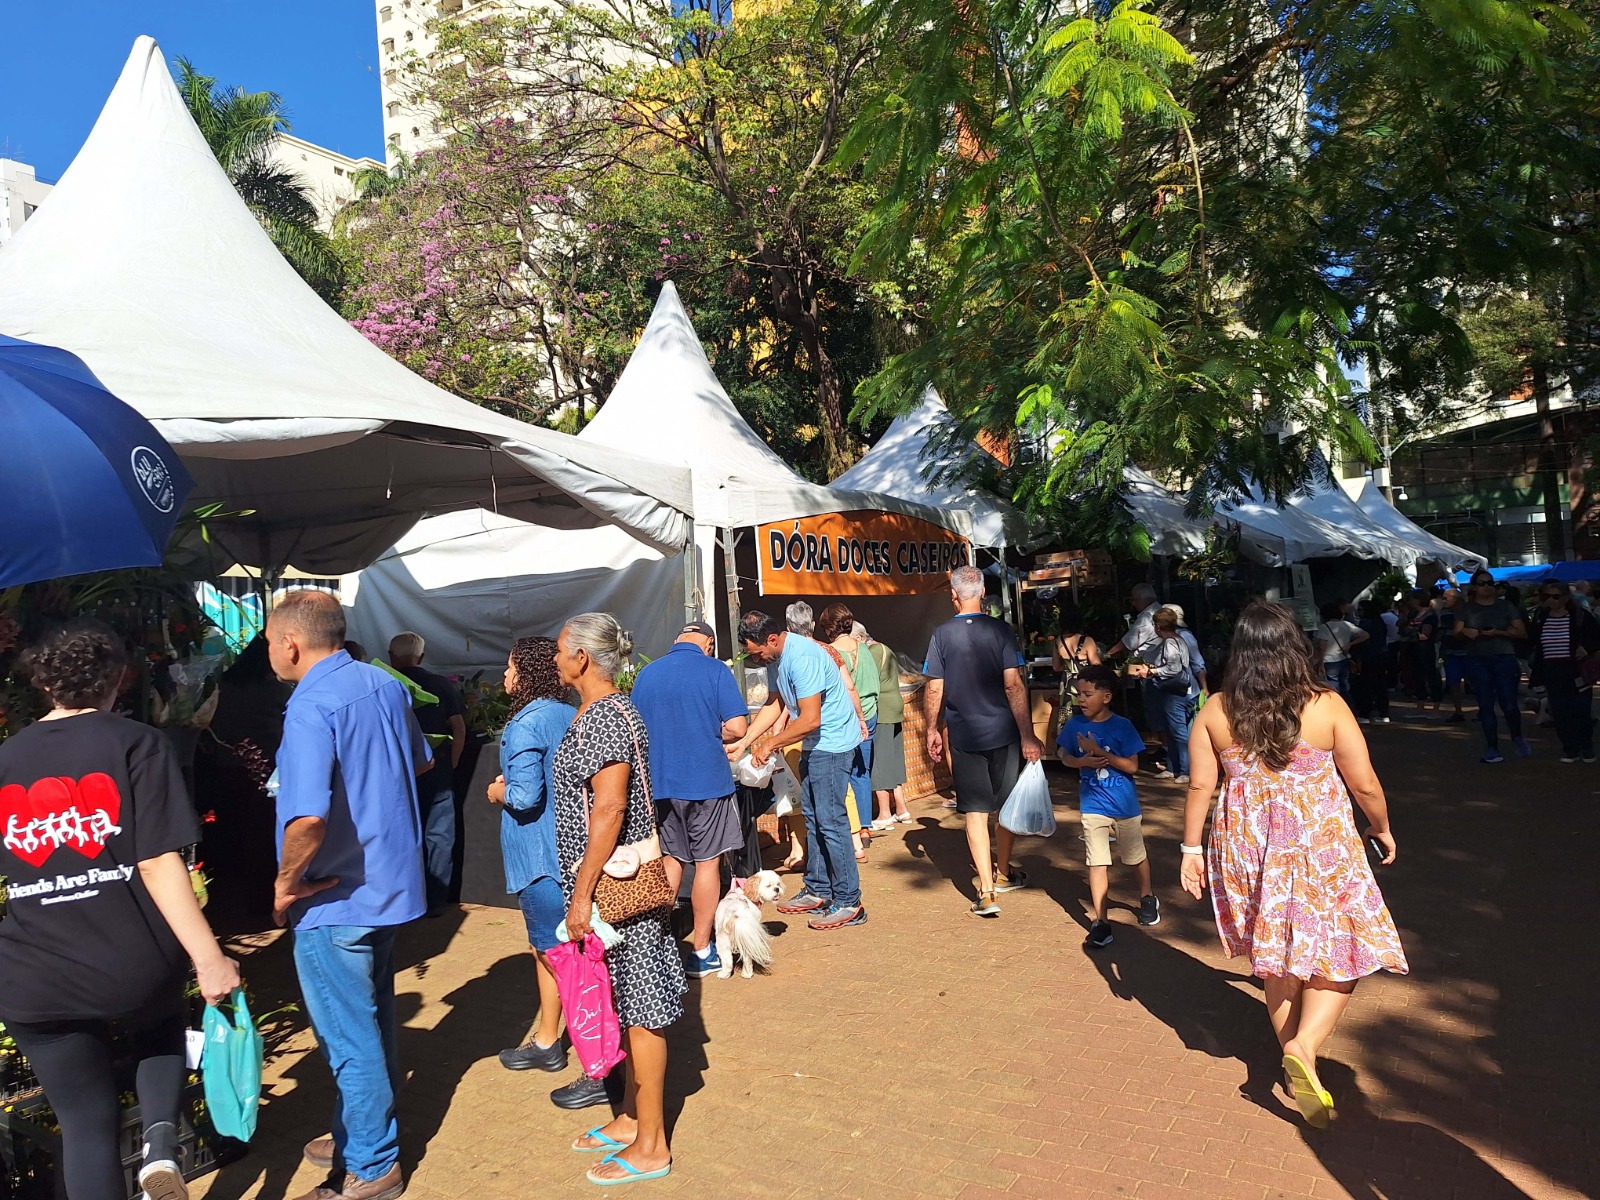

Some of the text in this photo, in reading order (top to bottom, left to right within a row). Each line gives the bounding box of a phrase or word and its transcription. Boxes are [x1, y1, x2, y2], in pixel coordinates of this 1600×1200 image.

[769, 520, 967, 575] DÓRA DOCES CASEIROS
[6, 878, 55, 899] riends
[55, 874, 88, 890] Are
